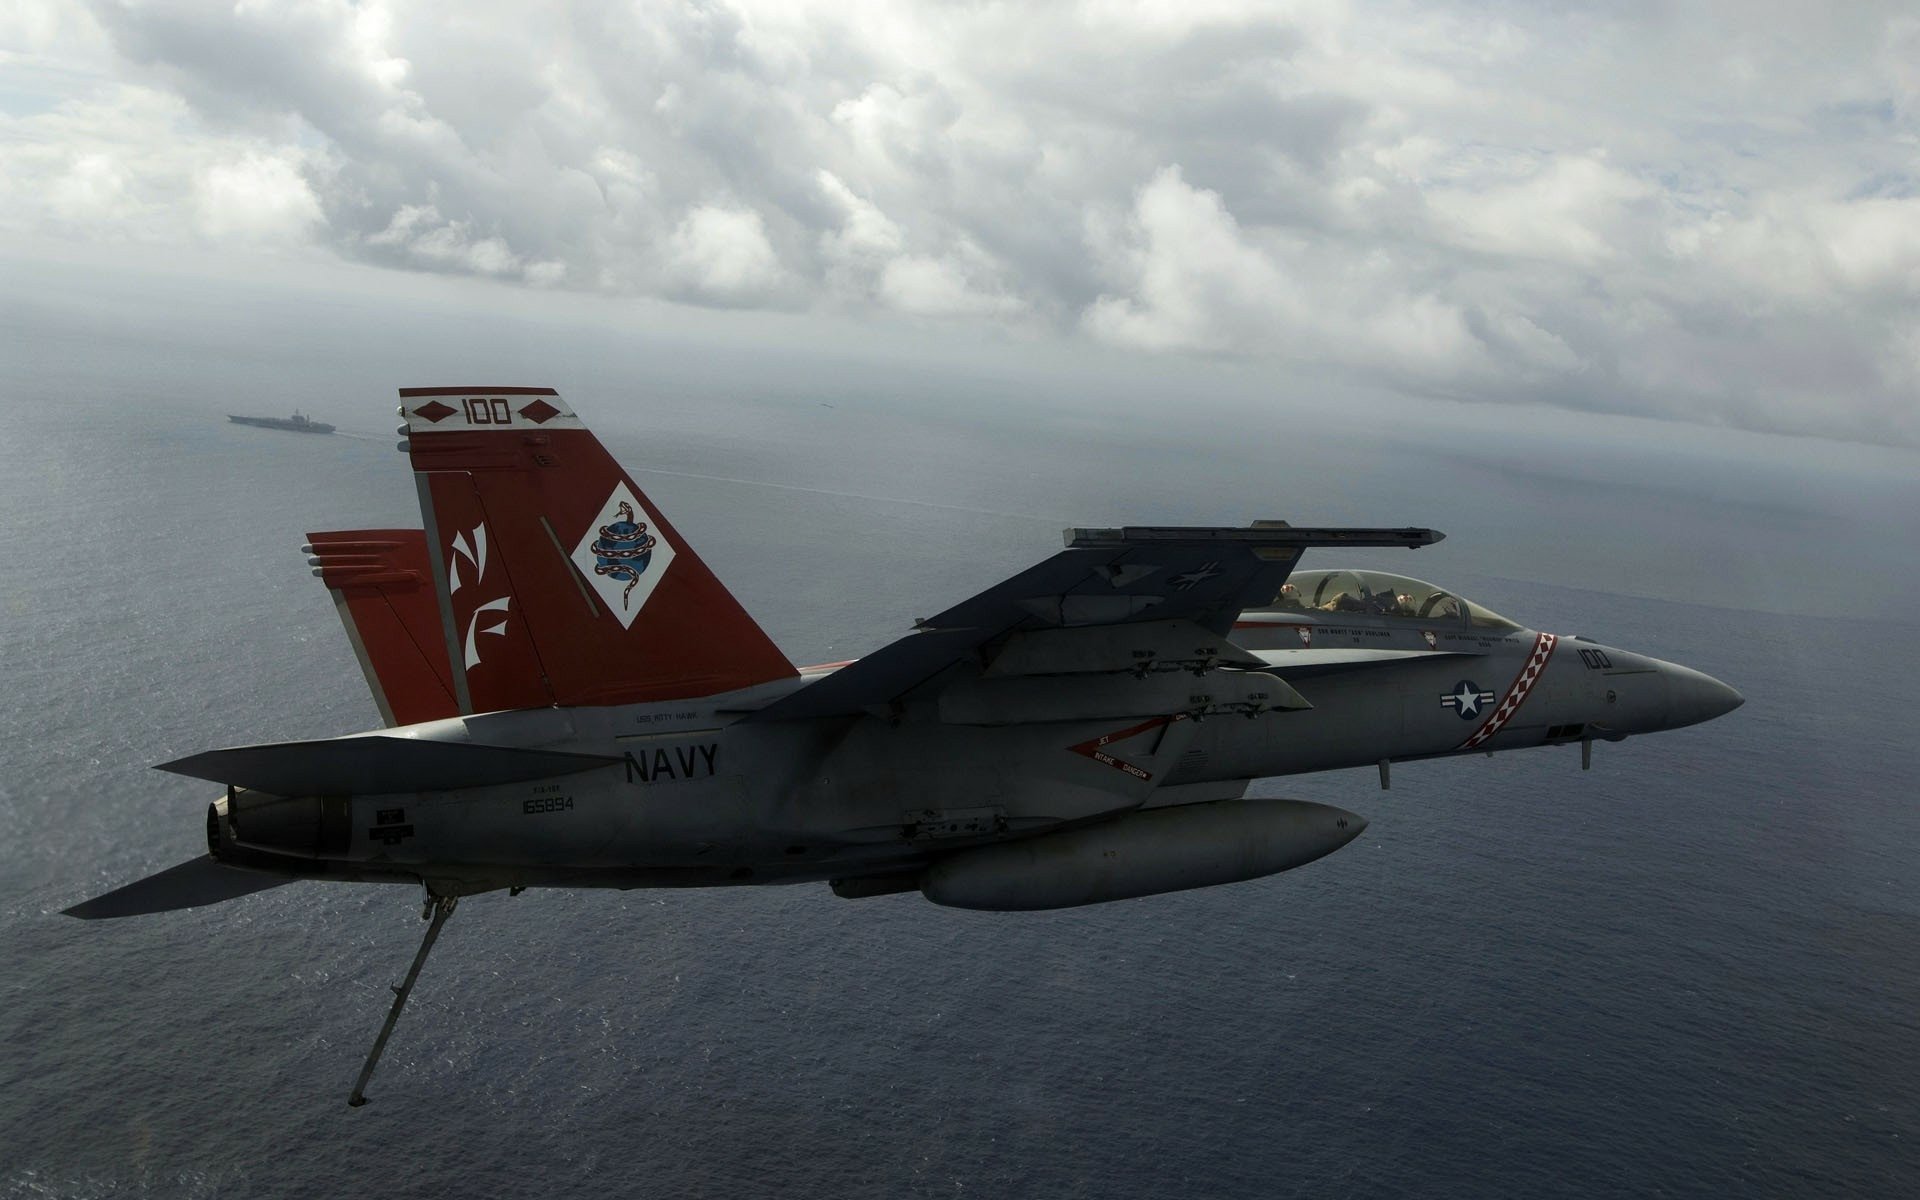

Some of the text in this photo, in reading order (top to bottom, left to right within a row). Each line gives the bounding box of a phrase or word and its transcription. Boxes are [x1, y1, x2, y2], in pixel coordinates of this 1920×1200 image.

[462, 398, 512, 424] 100
[1577, 649, 1612, 670] 100
[677, 712, 698, 721] HAWK
[1099, 736, 1109, 746] JET
[624, 744, 717, 783] NAVY
[1094, 752, 1144, 777] INTAKE DANGER
[523, 797, 573, 814] 165894
